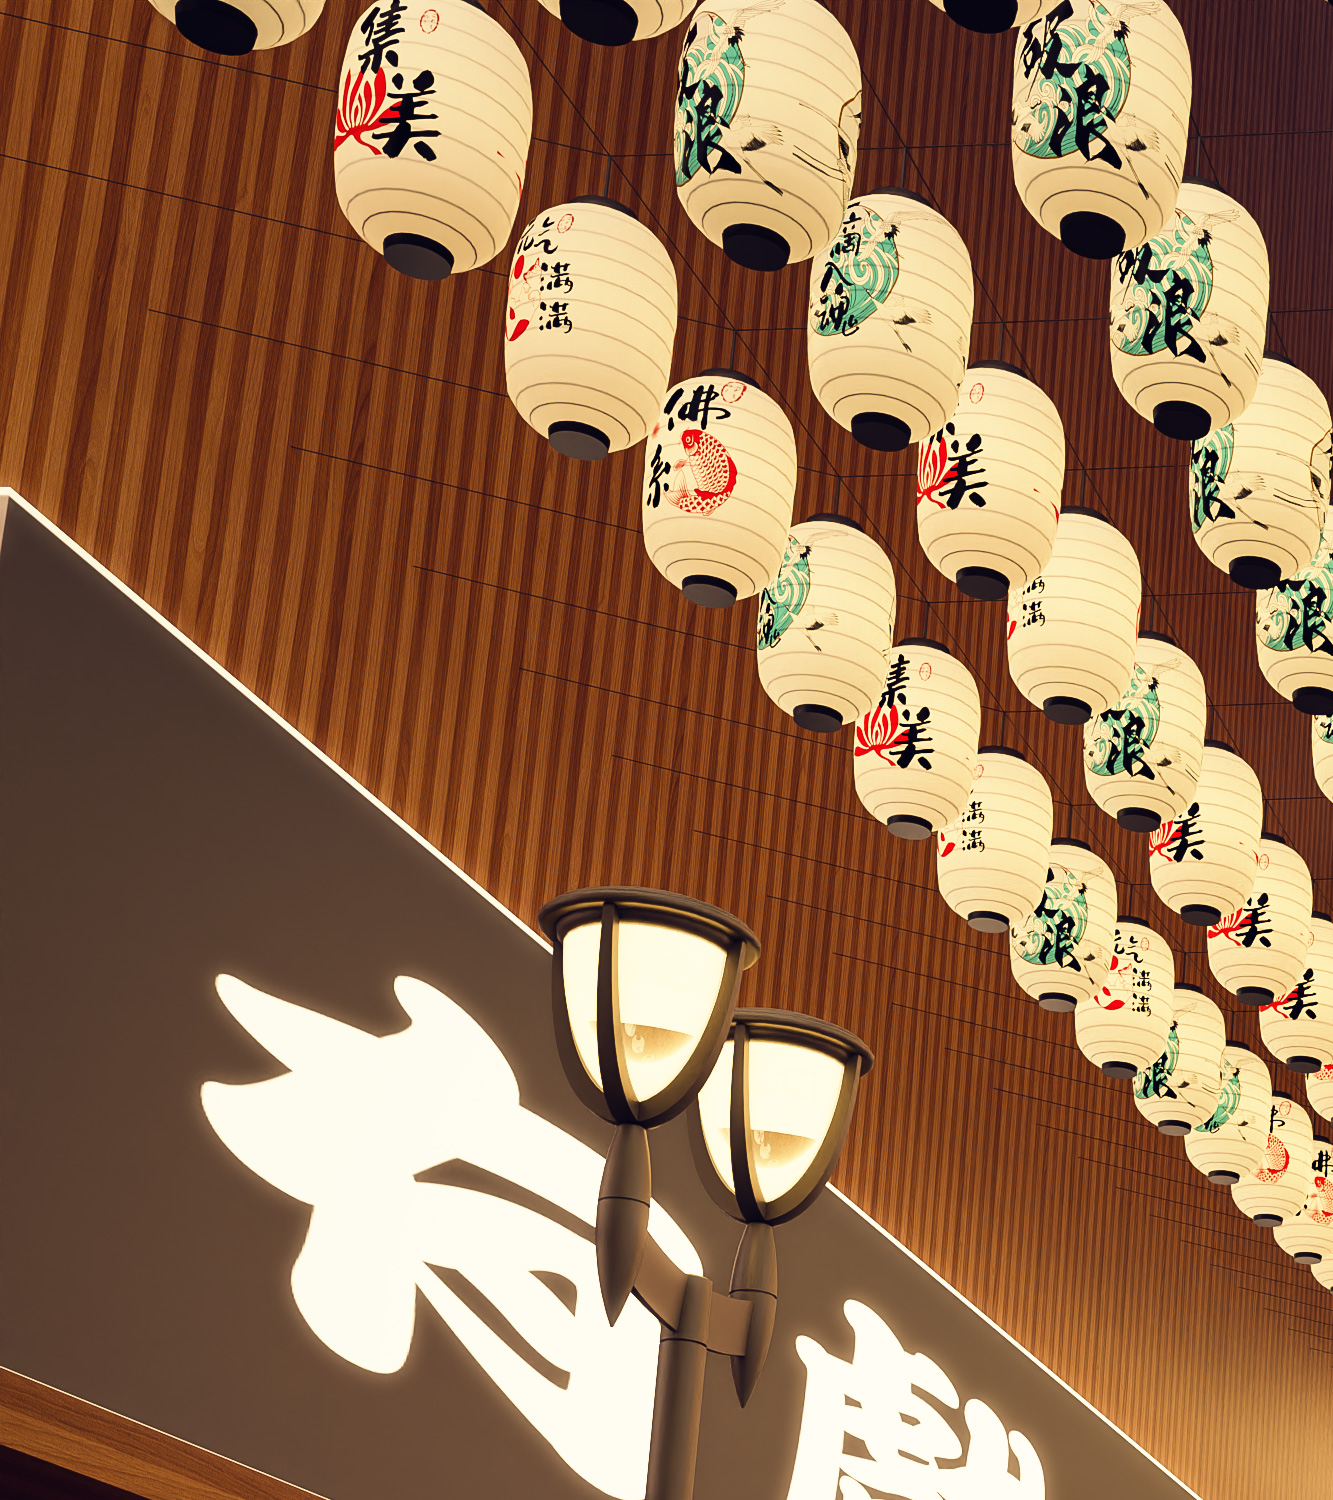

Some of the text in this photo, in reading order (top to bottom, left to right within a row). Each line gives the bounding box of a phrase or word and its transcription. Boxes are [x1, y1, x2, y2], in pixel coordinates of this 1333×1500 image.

[360, 2, 441, 161] 集美
[1024, 0, 1121, 168] 破浪
[540, 261, 574, 333] 满满
[646, 385, 731, 508] 佛系
